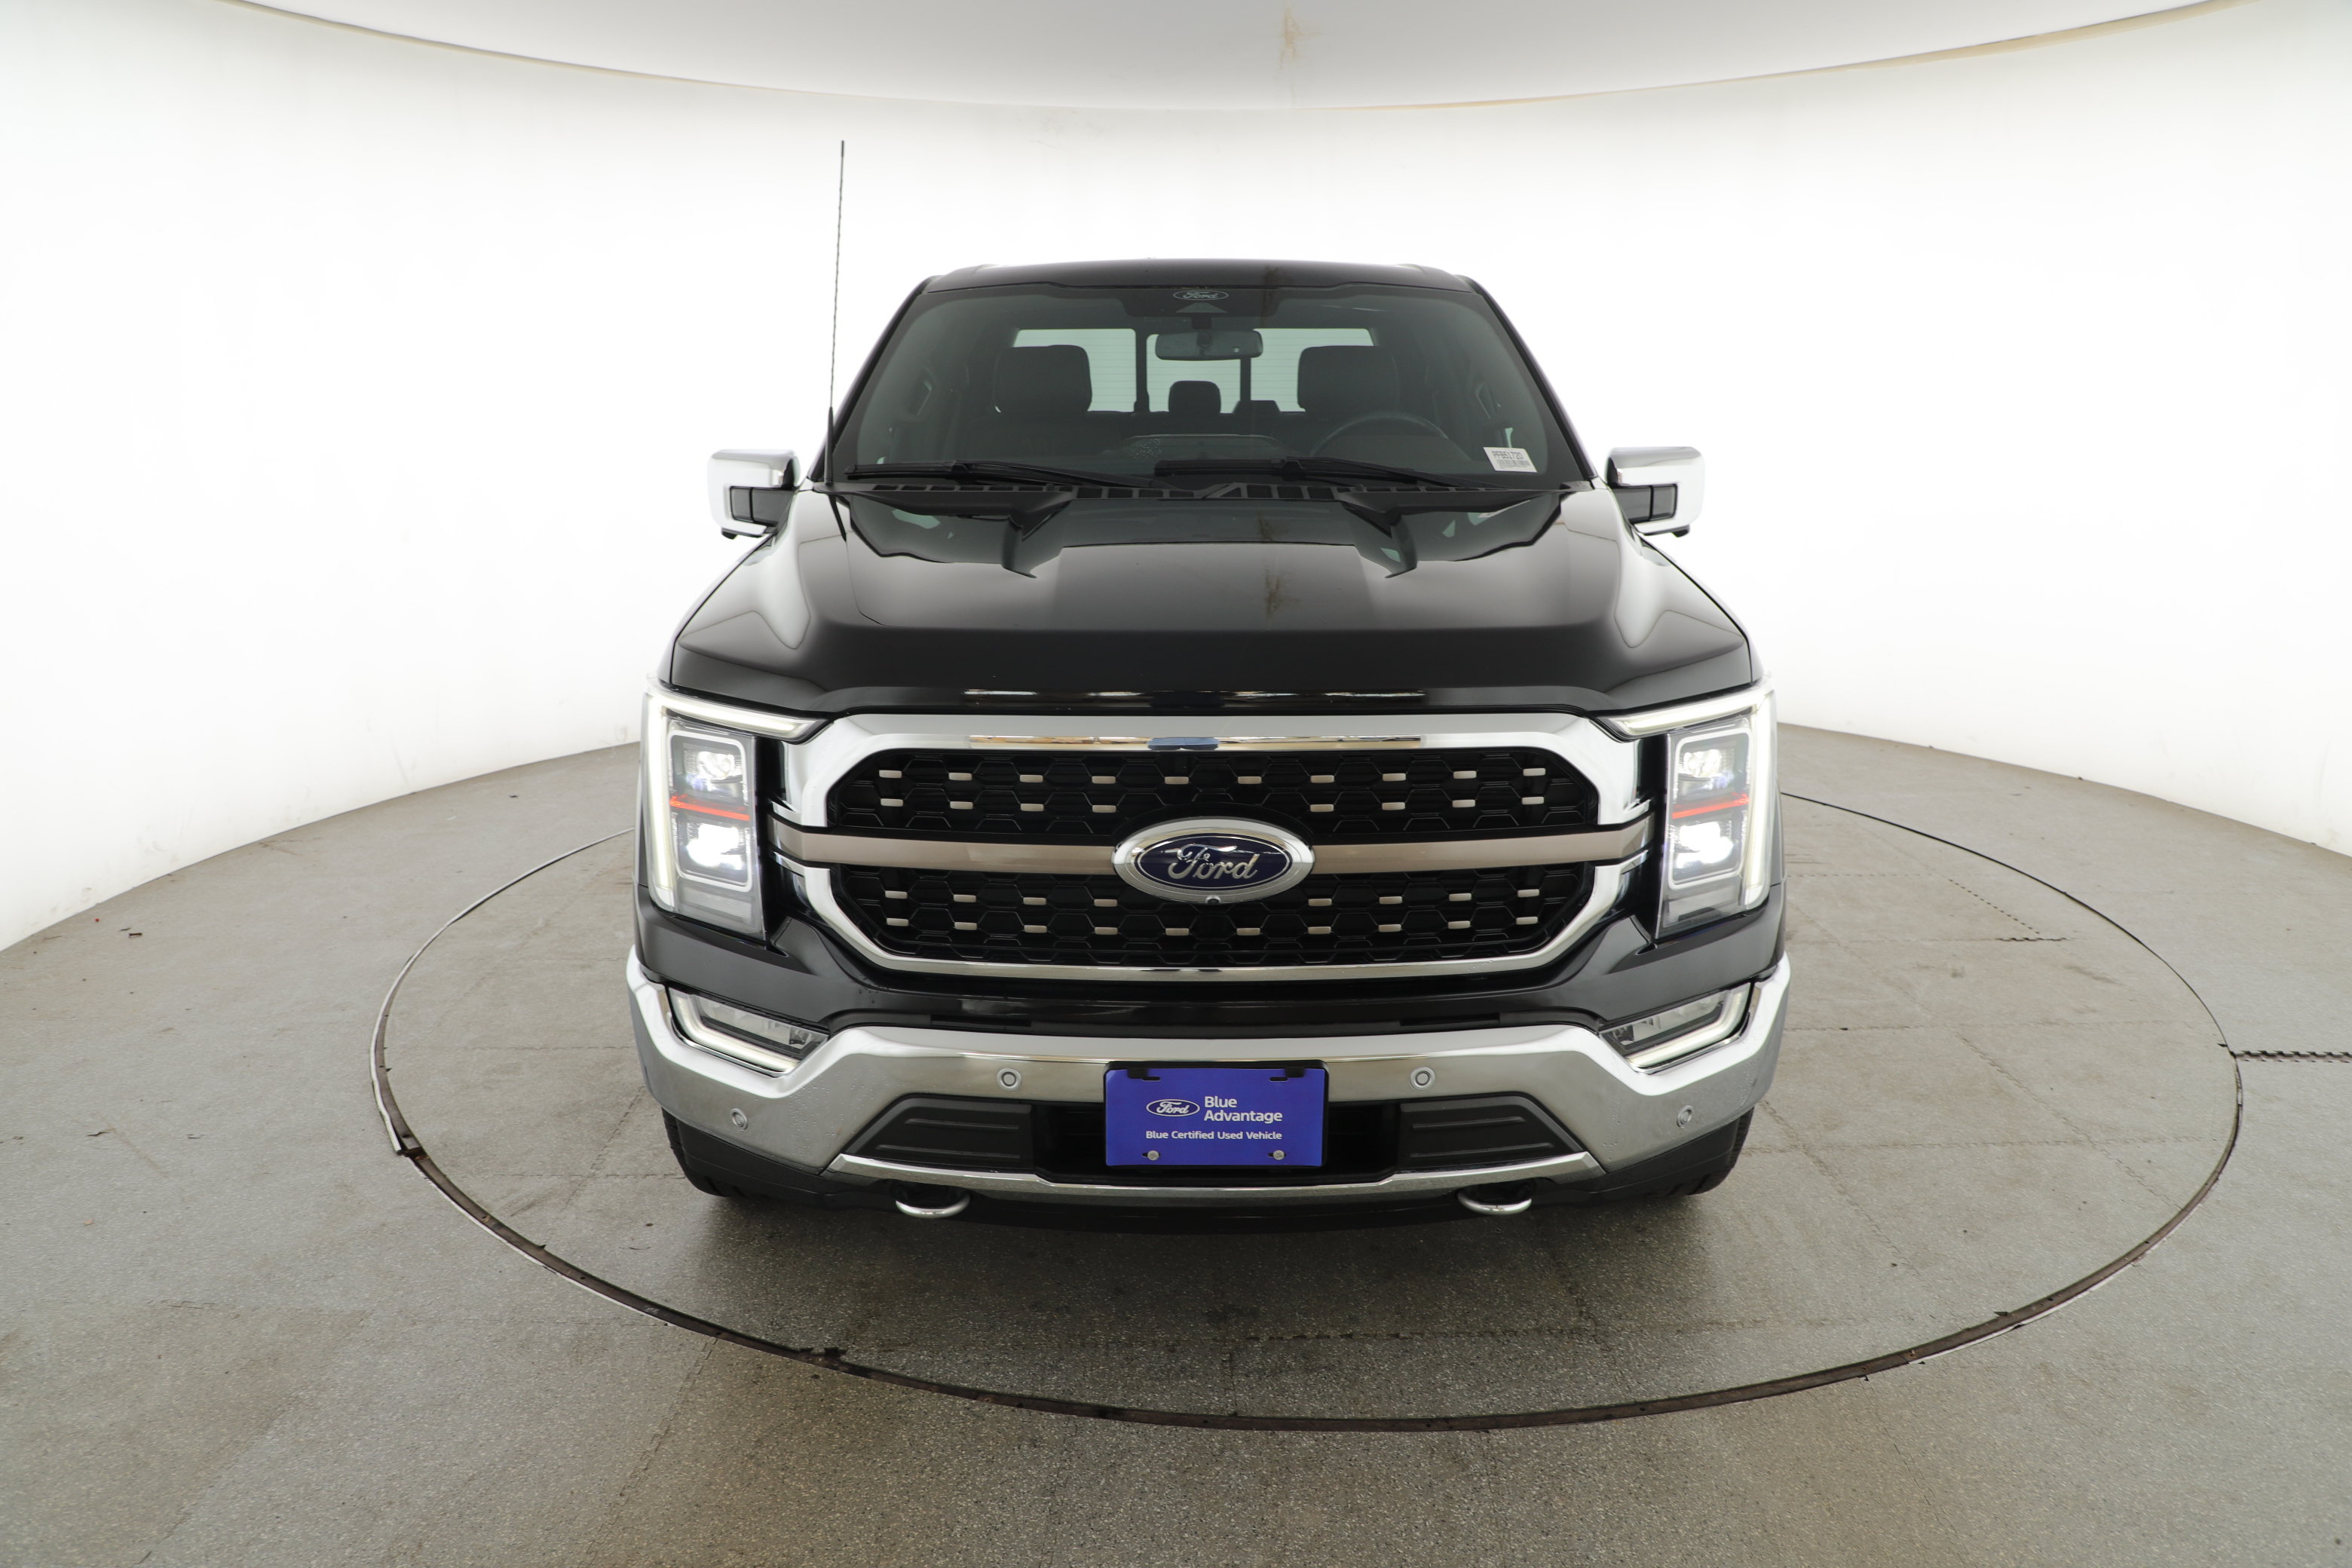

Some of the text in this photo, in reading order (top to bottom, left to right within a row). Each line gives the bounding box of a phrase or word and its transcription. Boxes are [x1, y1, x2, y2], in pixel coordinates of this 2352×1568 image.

[1183, 291, 1219, 299] Ford
[1167, 842, 1261, 880] Ford
[1156, 1101, 1190, 1114] Ford
[1204, 1095, 1238, 1108] Blue
[1203, 1109, 1283, 1124] Advantage
[1145, 1130, 1283, 1140] Blue Certified Used Vehicle
